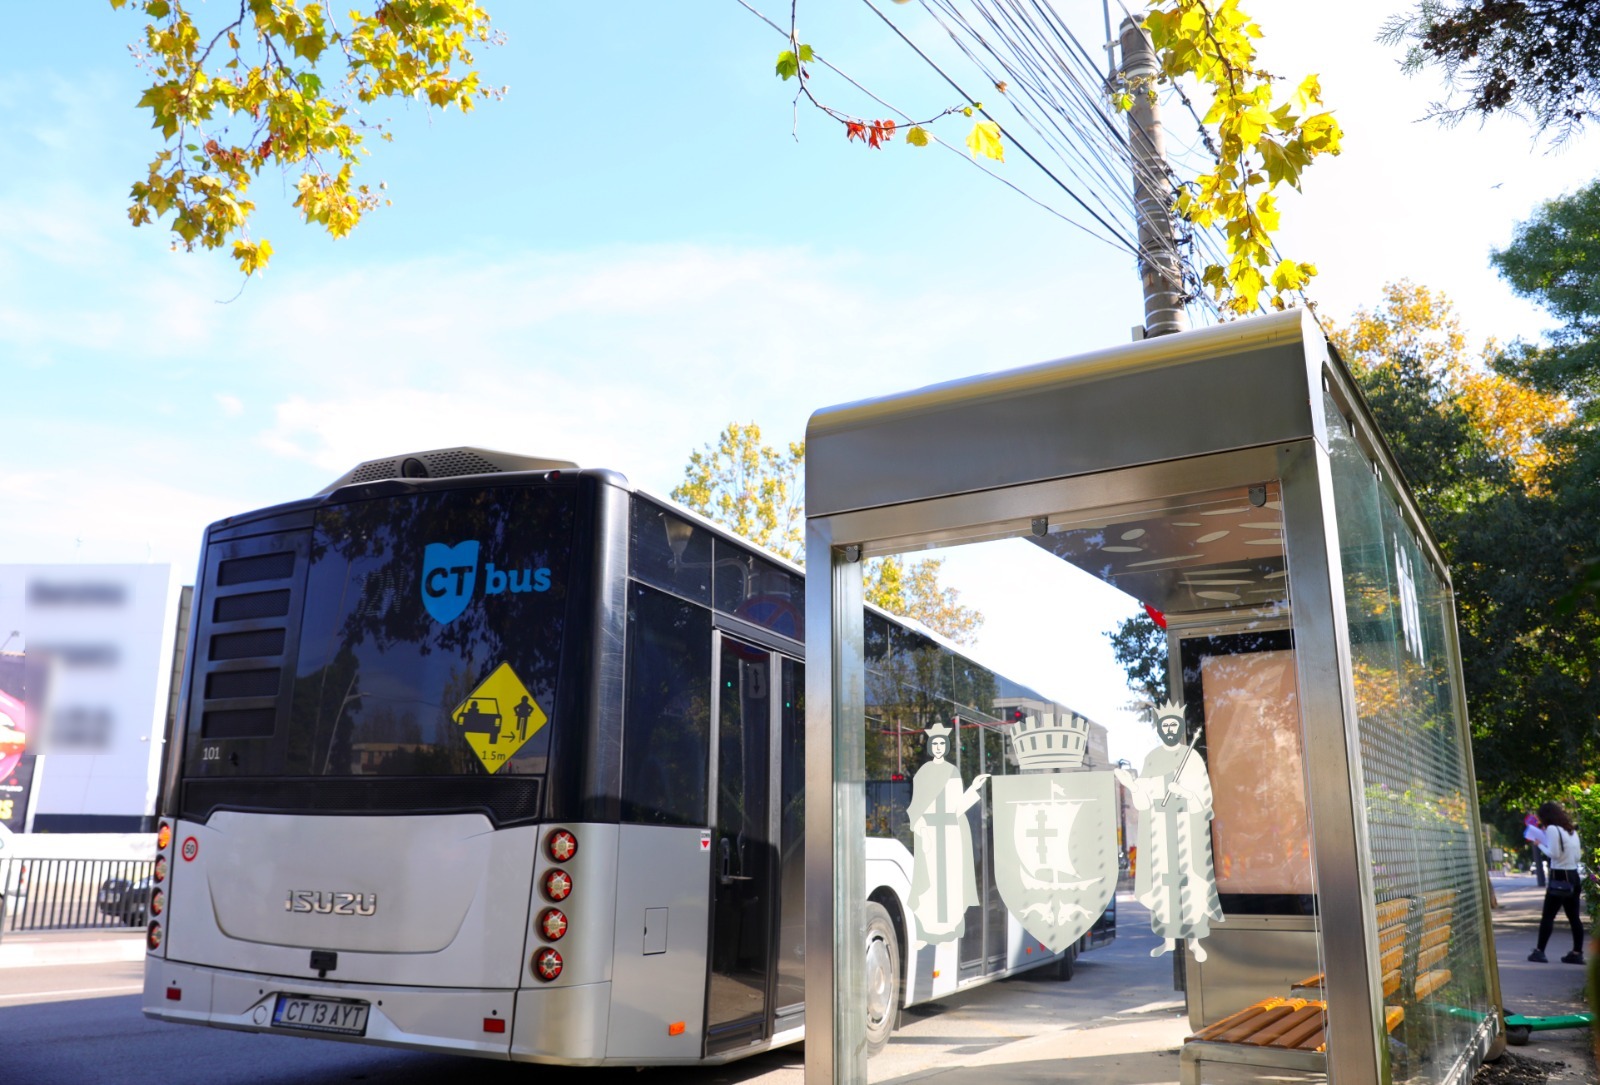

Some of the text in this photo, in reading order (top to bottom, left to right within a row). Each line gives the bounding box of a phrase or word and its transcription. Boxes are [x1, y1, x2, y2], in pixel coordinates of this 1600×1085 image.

[425, 562, 552, 598] CT bus
[203, 747, 220, 760] 101
[185, 844, 195, 855] 50
[285, 889, 377, 916] ISUZU
[286, 1001, 364, 1027] CT 13 AYT
